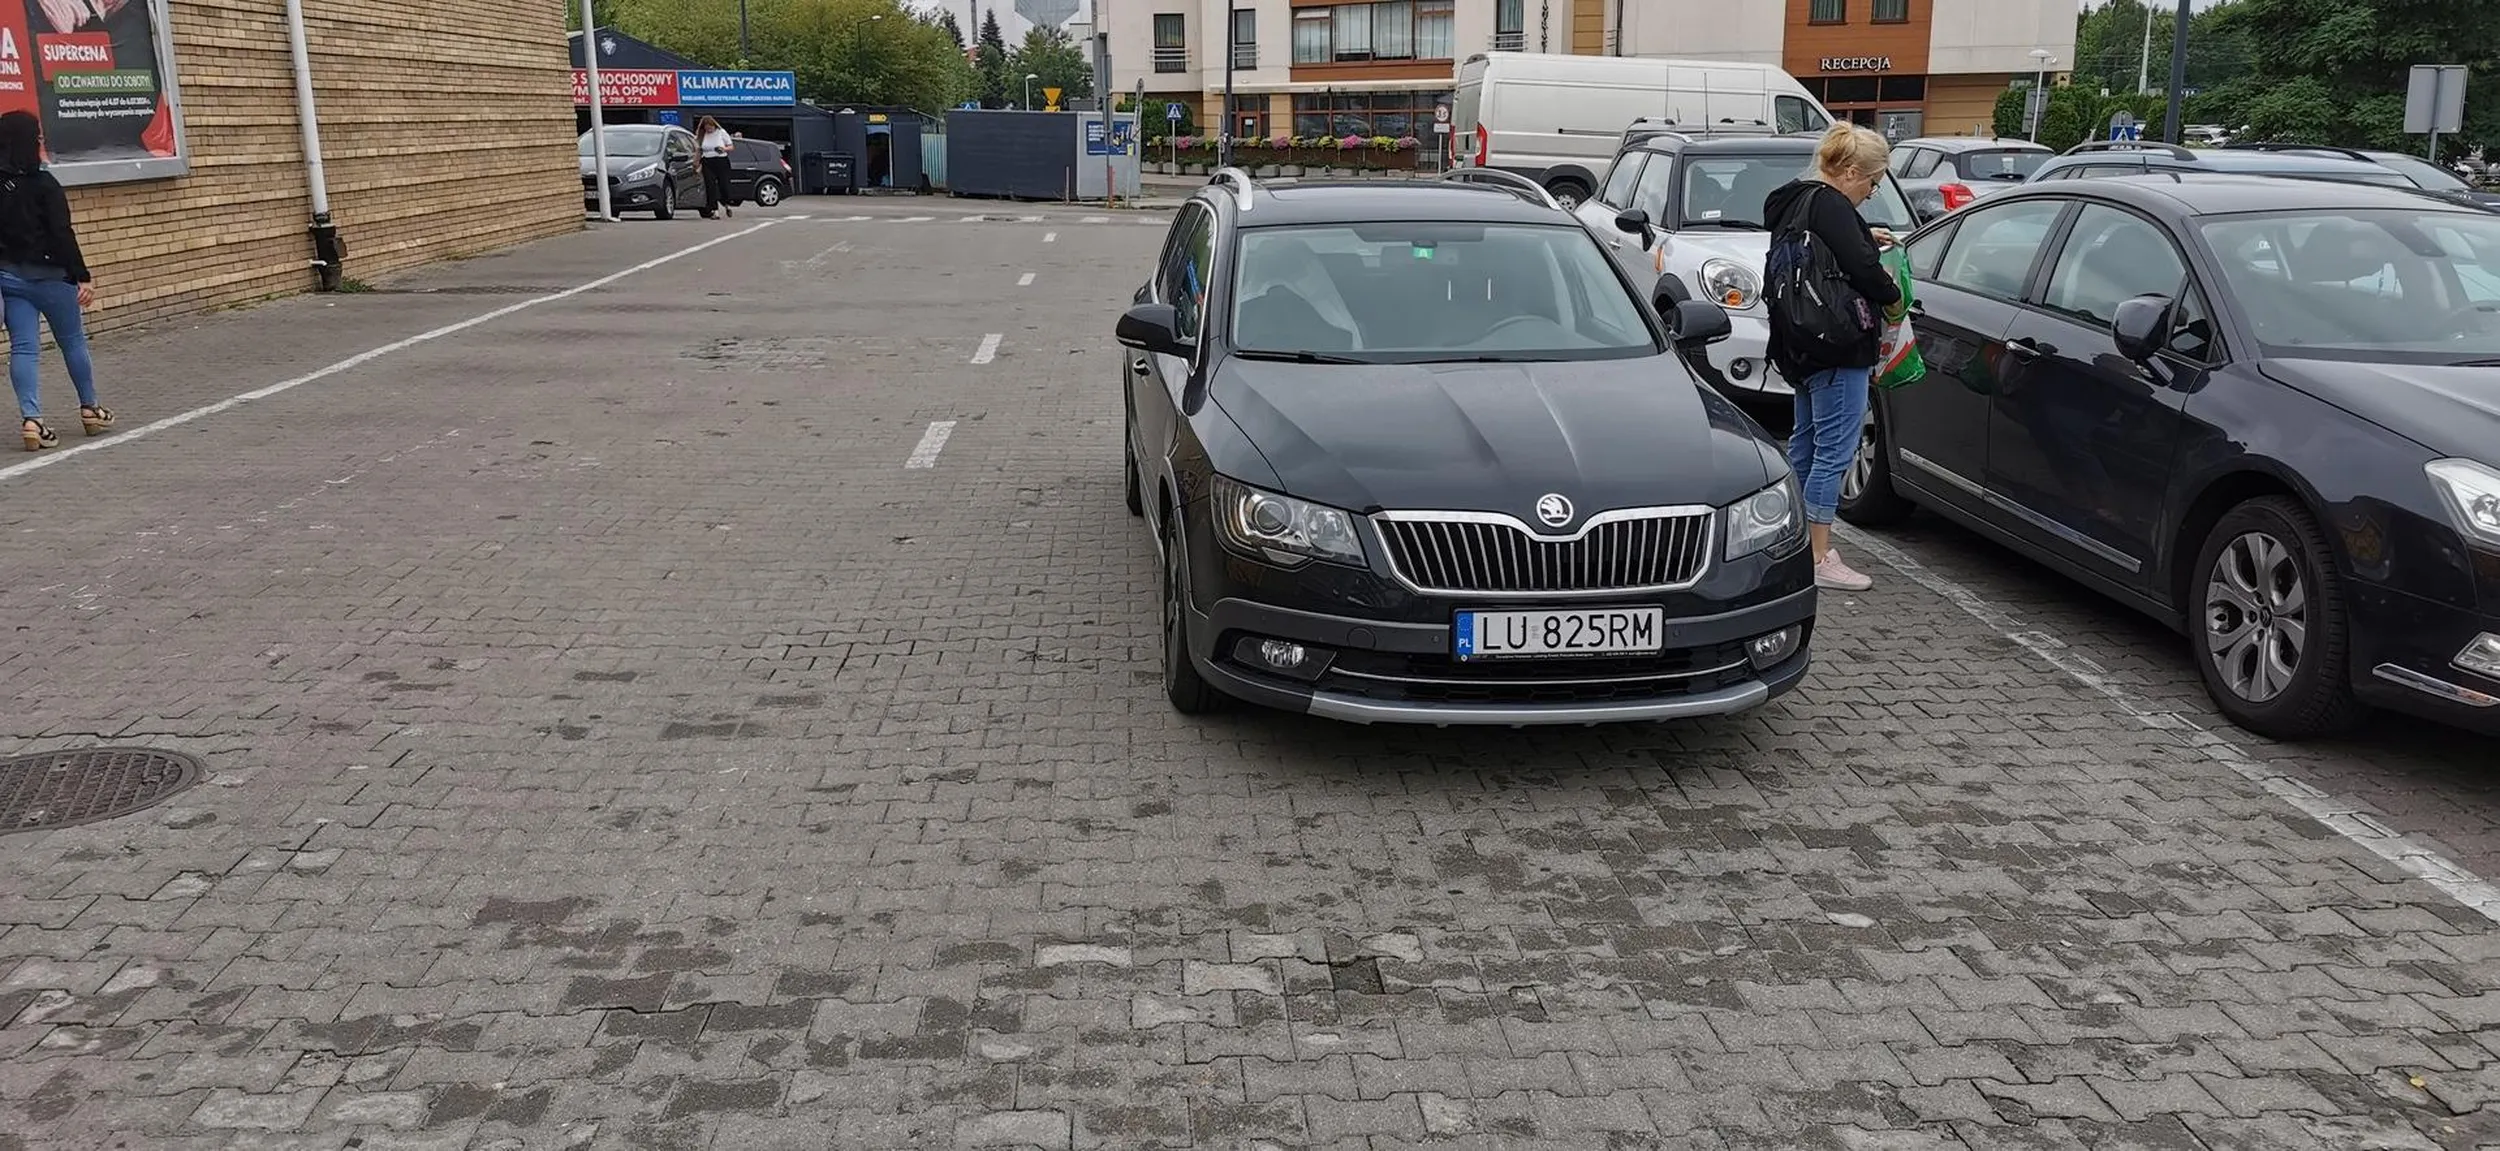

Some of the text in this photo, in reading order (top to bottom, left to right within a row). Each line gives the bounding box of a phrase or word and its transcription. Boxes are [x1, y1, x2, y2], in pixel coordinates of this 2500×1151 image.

[43, 44, 109, 62] SUPERCENA
[1821, 57, 1892, 72] RECEPCJA
[58, 75, 70, 88] OD
[111, 75, 123, 88] DO
[580, 73, 673, 86] SMOCHODOWY
[681, 76, 791, 90] KLIMATYZACJA
[622, 86, 657, 97] OPON
[1482, 612, 1653, 650] LU 825RM
[1458, 637, 1472, 648] PL
